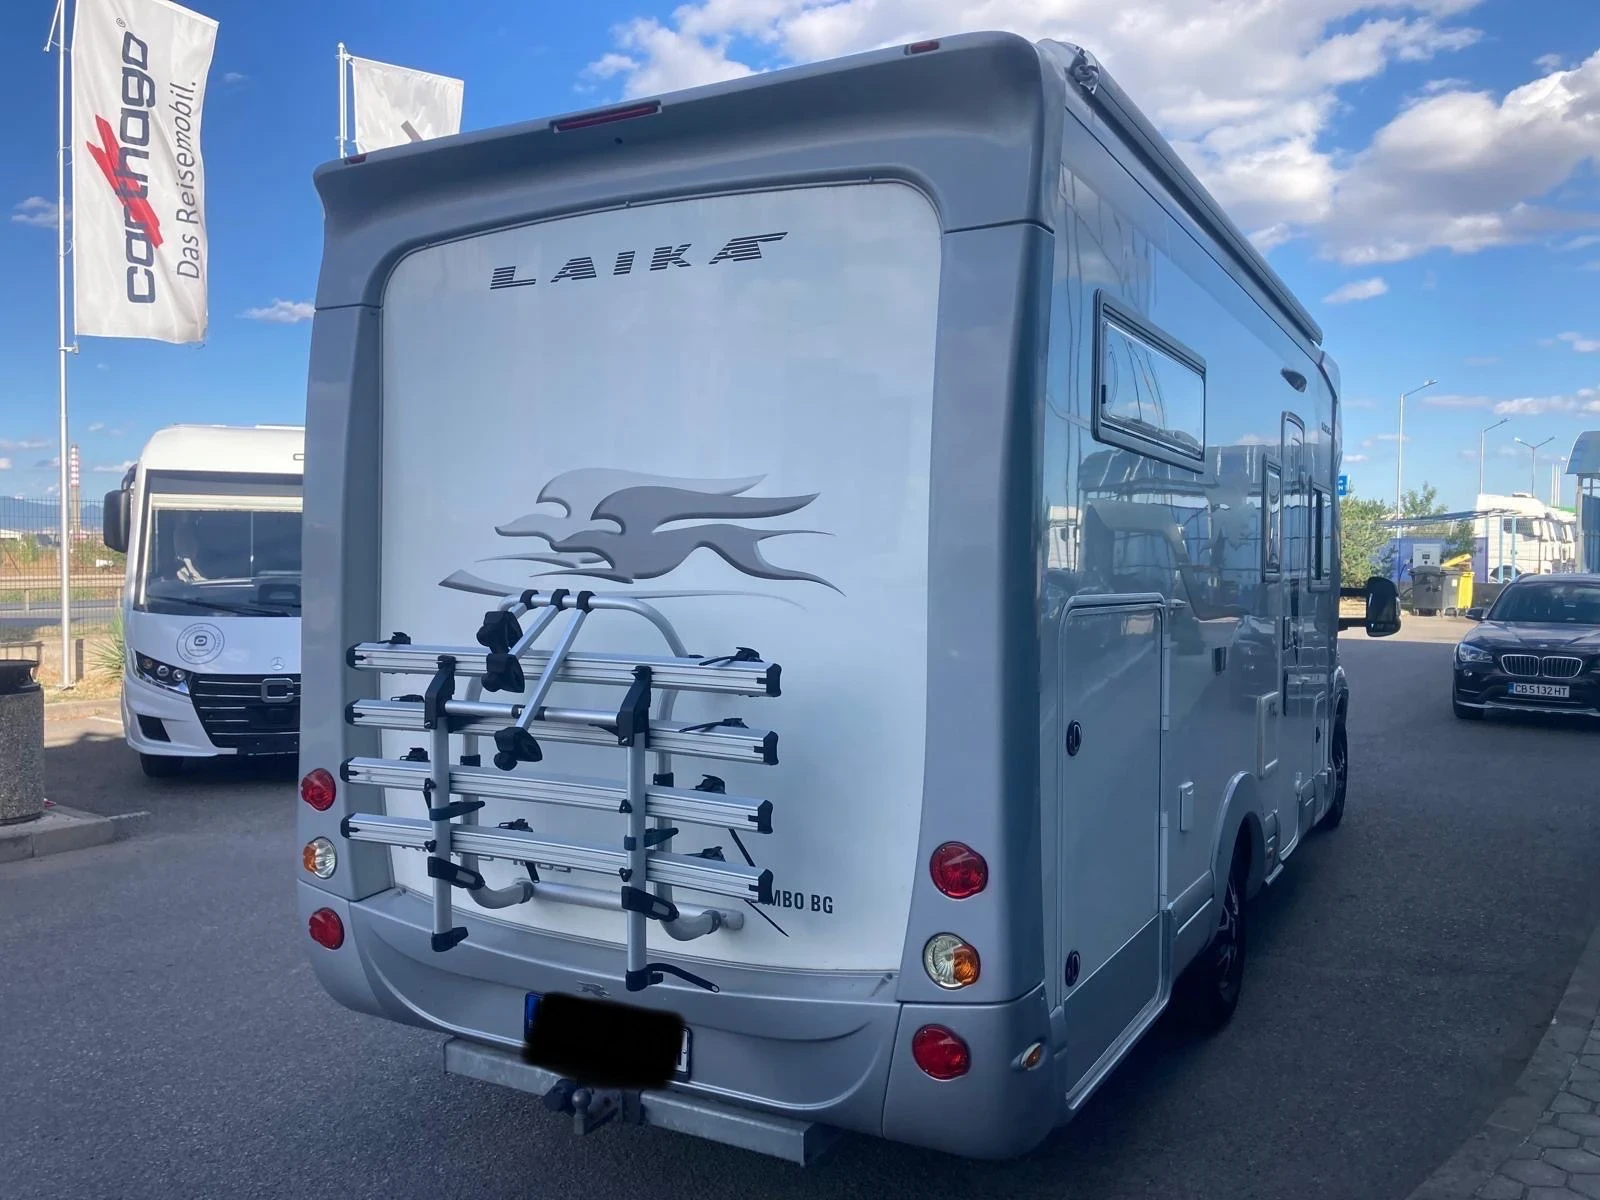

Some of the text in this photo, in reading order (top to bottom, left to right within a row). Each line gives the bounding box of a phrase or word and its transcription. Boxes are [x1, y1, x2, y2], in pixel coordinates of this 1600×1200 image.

[115, 31, 156, 304] carthago
[168, 81, 200, 279] Das Reisemobil.
[490, 231, 789, 290] LAIKA
[766, 889, 833, 914] MBO BG
